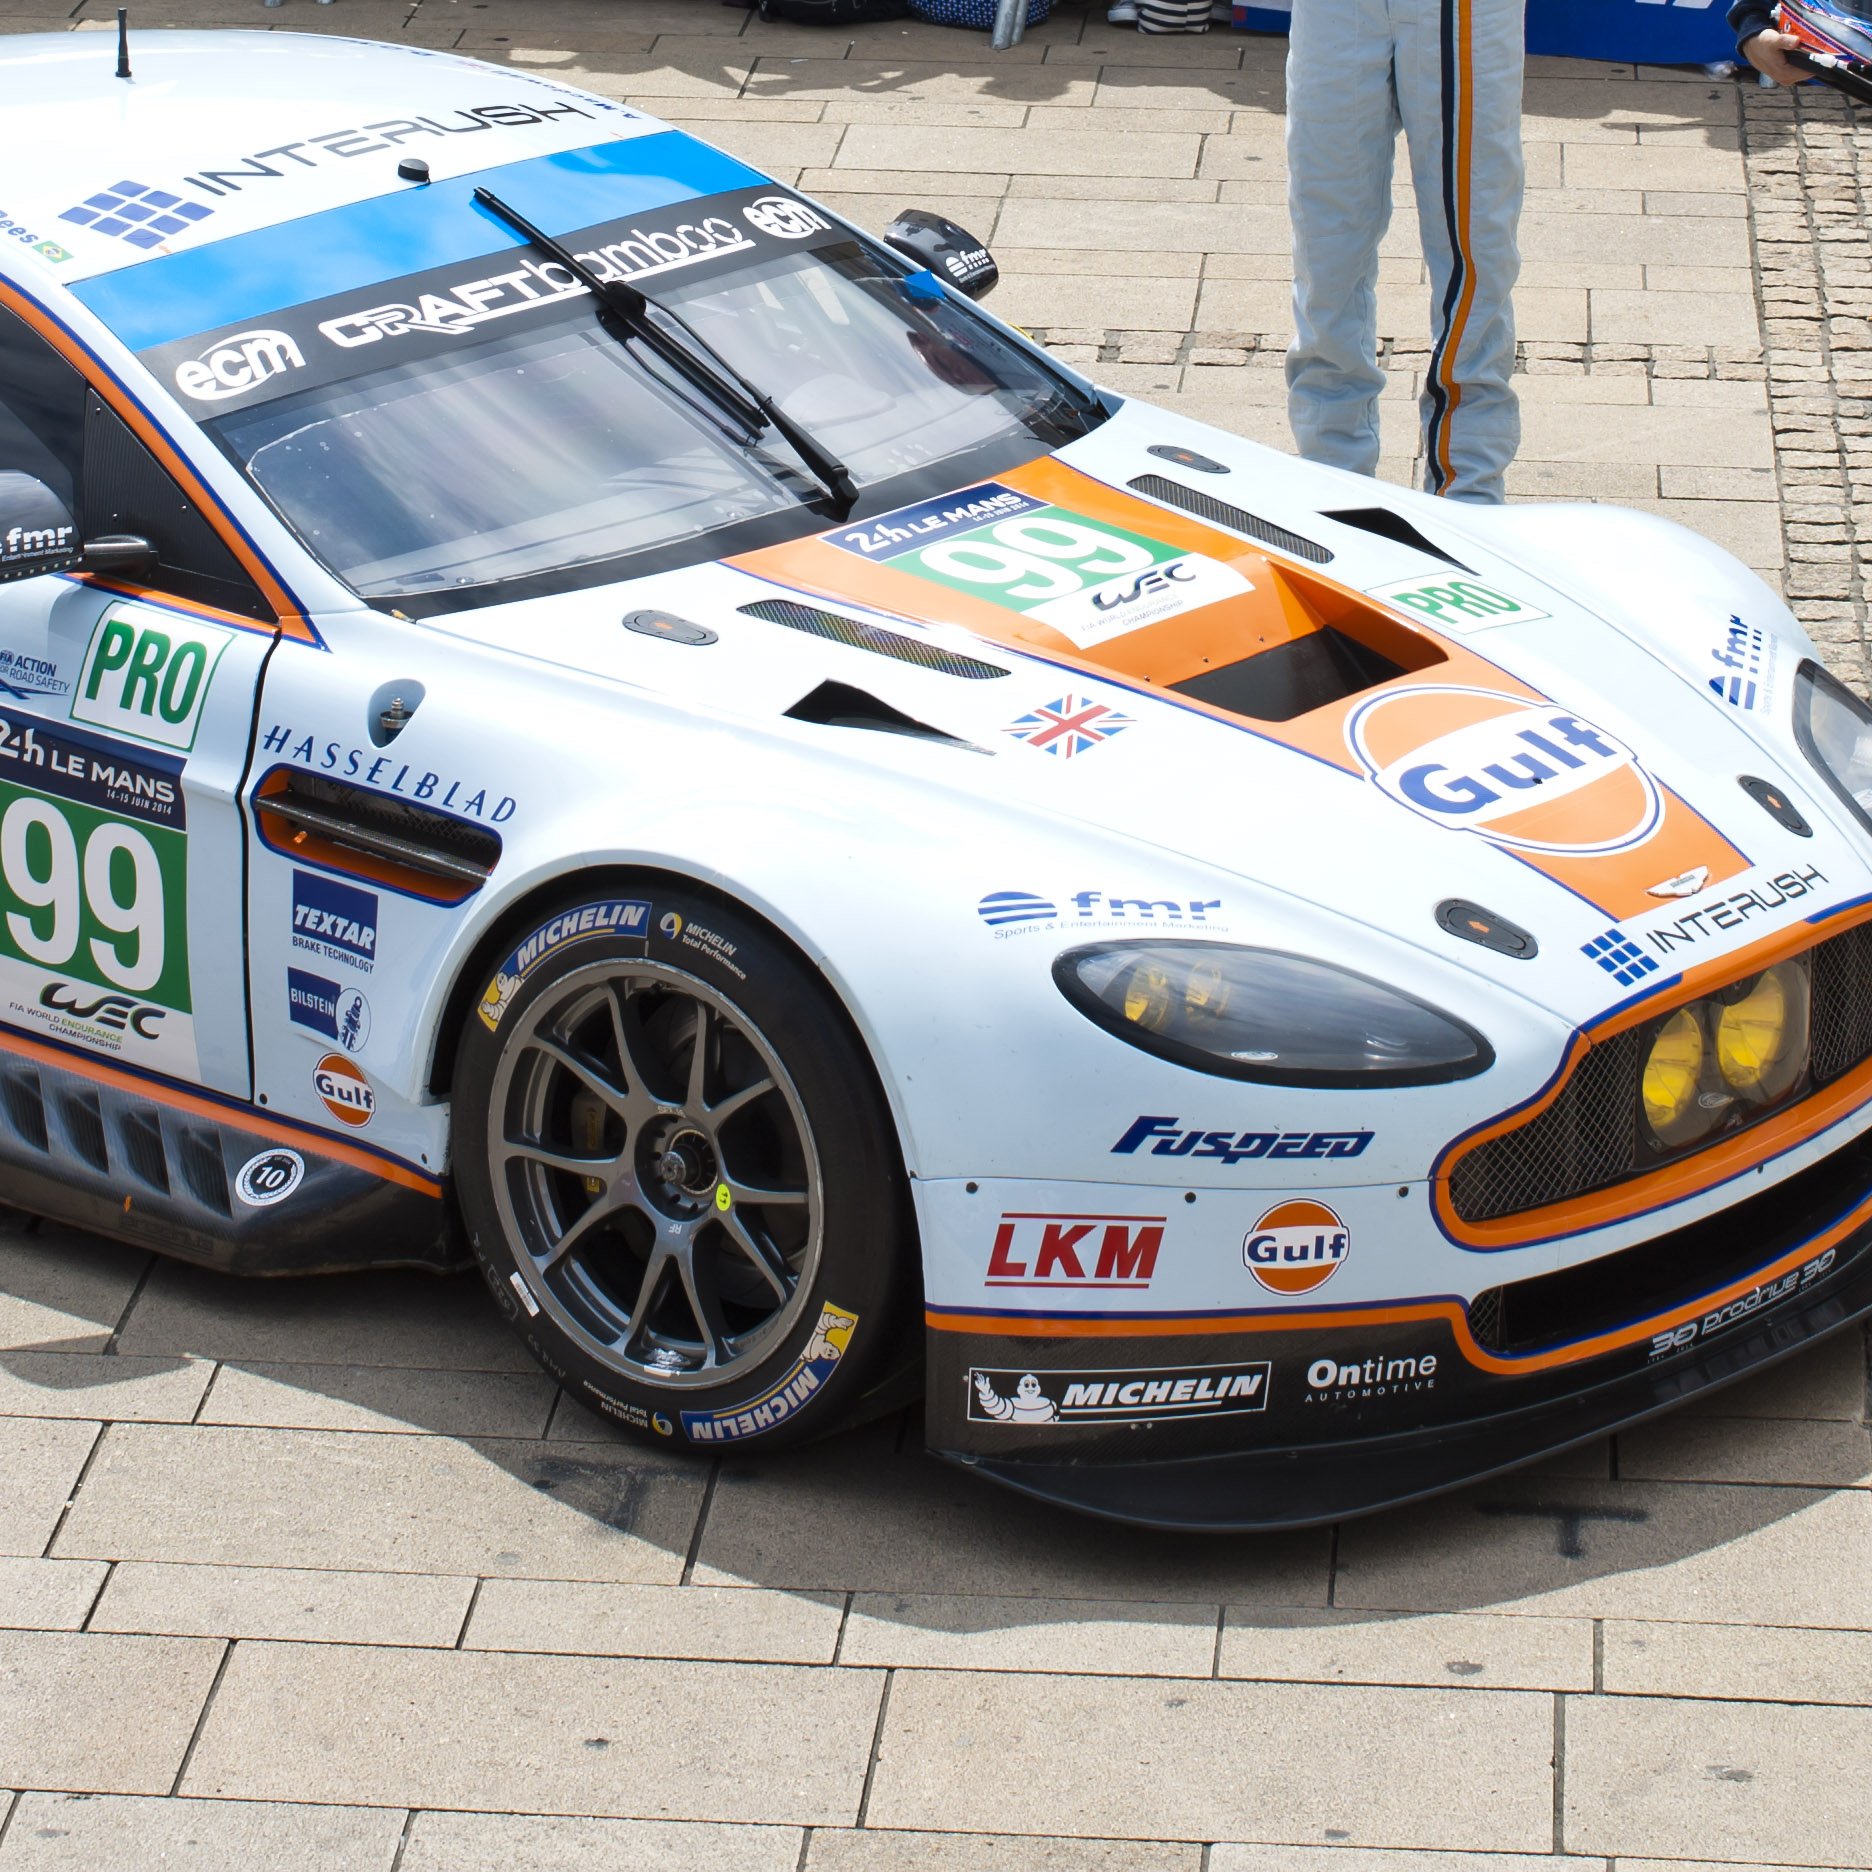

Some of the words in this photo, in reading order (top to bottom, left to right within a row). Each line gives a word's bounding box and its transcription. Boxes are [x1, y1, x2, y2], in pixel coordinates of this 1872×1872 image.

[183, 101, 597, 197] INTERUSH
[174, 329, 307, 402] ecm
[741, 196, 833, 240] ecm
[0, 521, 60, 548] fmr
[845, 518, 913, 554] 24h
[907, 512, 944, 537] LE
[940, 490, 1024, 528] MANS
[919, 515, 1157, 601] 99
[1090, 562, 1199, 612] WEC
[1396, 578, 1524, 626] PRO
[9, 666, 36, 685] ROAD
[35, 674, 71, 695] SAFETY
[14, 656, 57, 678] ACTION
[86, 619, 208, 725] PRO
[50, 750, 85, 781] LE
[90, 758, 177, 804] MANS
[263, 725, 518, 826] HASSELBLAD
[1398, 715, 1601, 815] Gulf
[0, 797, 165, 993] 99
[1070, 890, 1222, 921] fmr
[1645, 863, 1829, 954] INTERUSH
[293, 903, 377, 953] TEXTAR
[516, 902, 648, 973] MICHELIN
[684, 921, 738, 957] MICHELIN
[993, 923, 1040, 941] Sports
[1059, 917, 1159, 930] Entertainment
[1162, 918, 1229, 934] Marketing
[292, 935, 323, 958] BRAKE
[323, 943, 376, 976] TECHNOLOGY
[681, 933, 703, 950] Total
[701, 943, 748, 981] Performance
[28, 1005, 62, 1027] WORLD
[60, 1017, 124, 1045] ENDURANCE
[40, 980, 168, 1042] WEC
[290, 985, 336, 1018] BILSTEIN
[49, 1022, 123, 1052] CHAMPIONSHIP
[315, 1071, 376, 1111] Gulf
[256, 1165, 285, 1190] 10
[987, 1223, 1166, 1279] LKM
[1247, 1232, 1348, 1264] Gulf
[1701, 1271, 1801, 1335] prodrive
[1062, 1373, 1264, 1408] MICHELIN
[1305, 1379, 1435, 1403] AUTOMOTIVE
[1306, 1354, 1438, 1391] Ontime
[691, 1366, 821, 1444] MICHELIN
